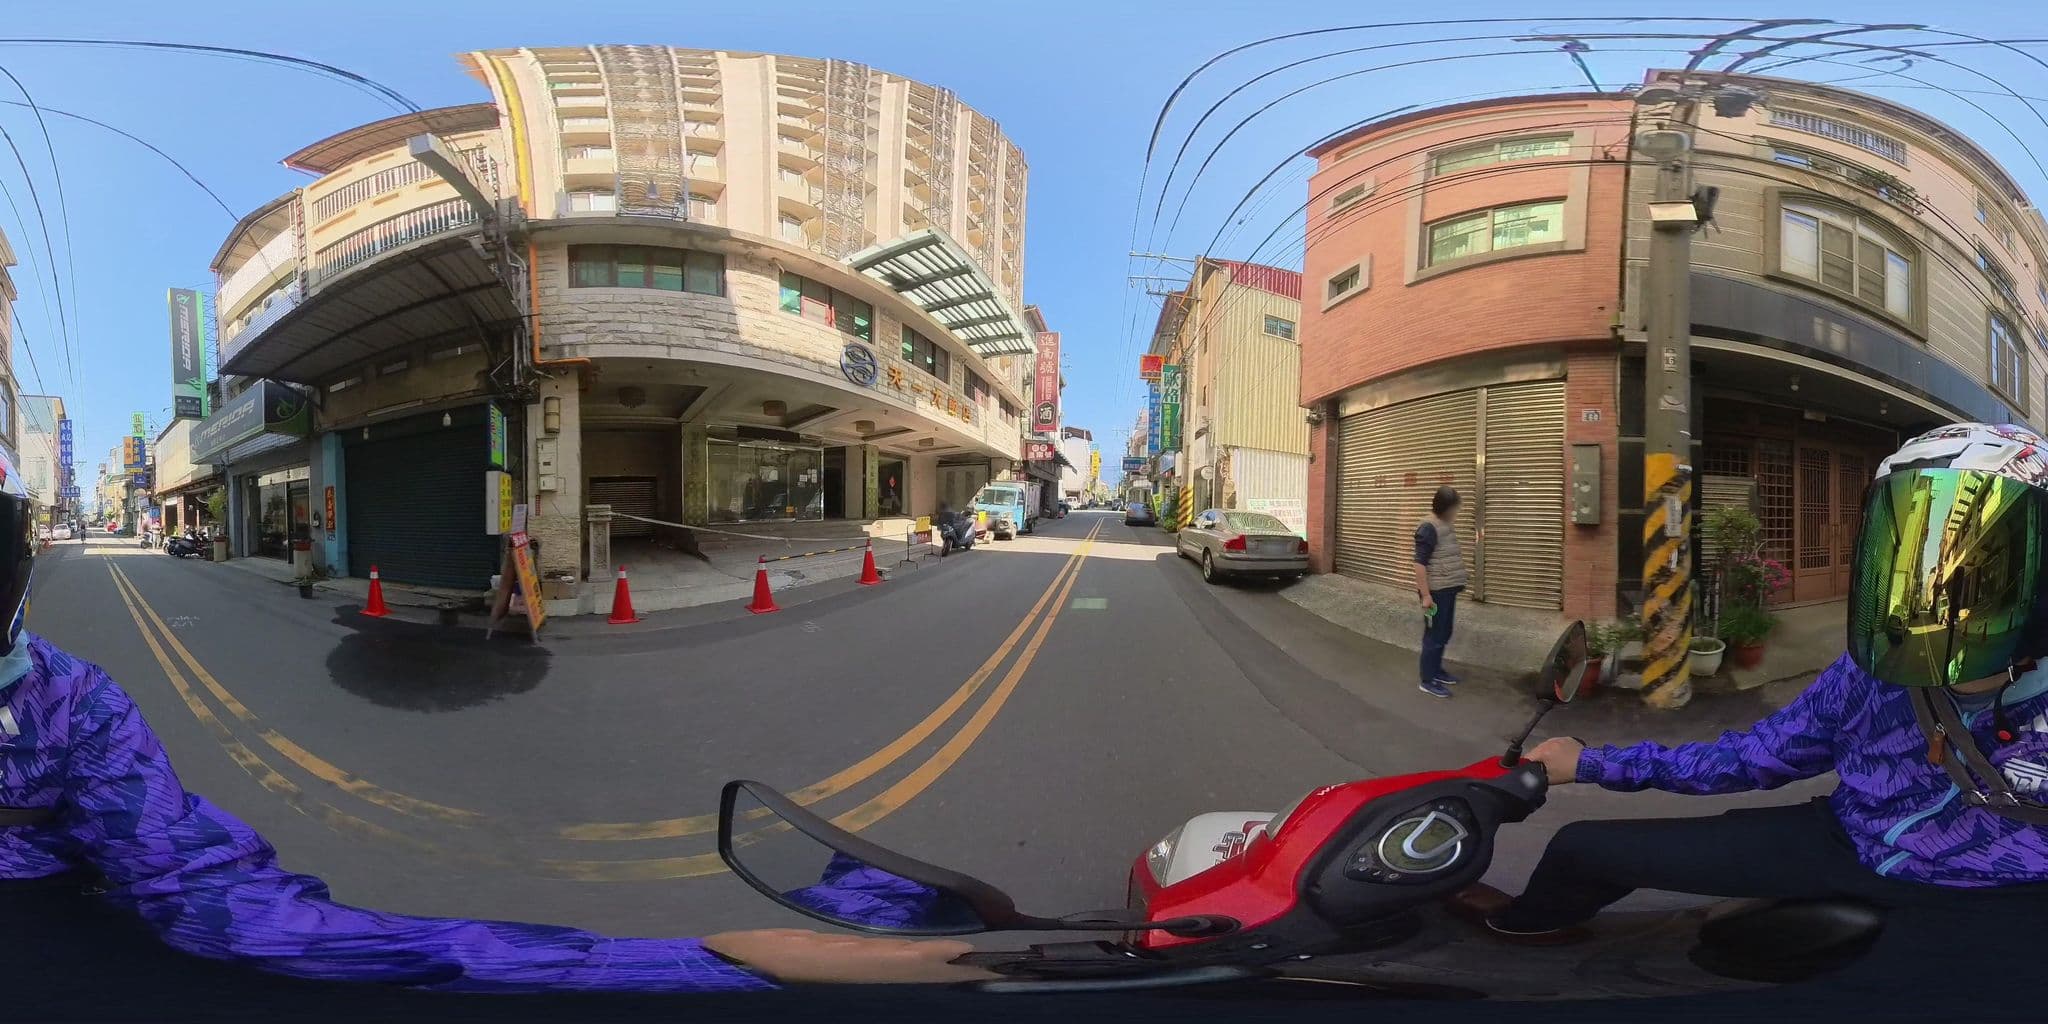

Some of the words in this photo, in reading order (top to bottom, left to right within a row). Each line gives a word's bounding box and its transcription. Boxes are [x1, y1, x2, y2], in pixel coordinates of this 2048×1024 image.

[179, 304, 192, 371] MERIDA
[1039, 335, 1056, 374] 進南號
[886, 365, 972, 425] 天一大飯店
[1039, 407, 1053, 421] 酒
[199, 398, 256, 440] MERIDA
